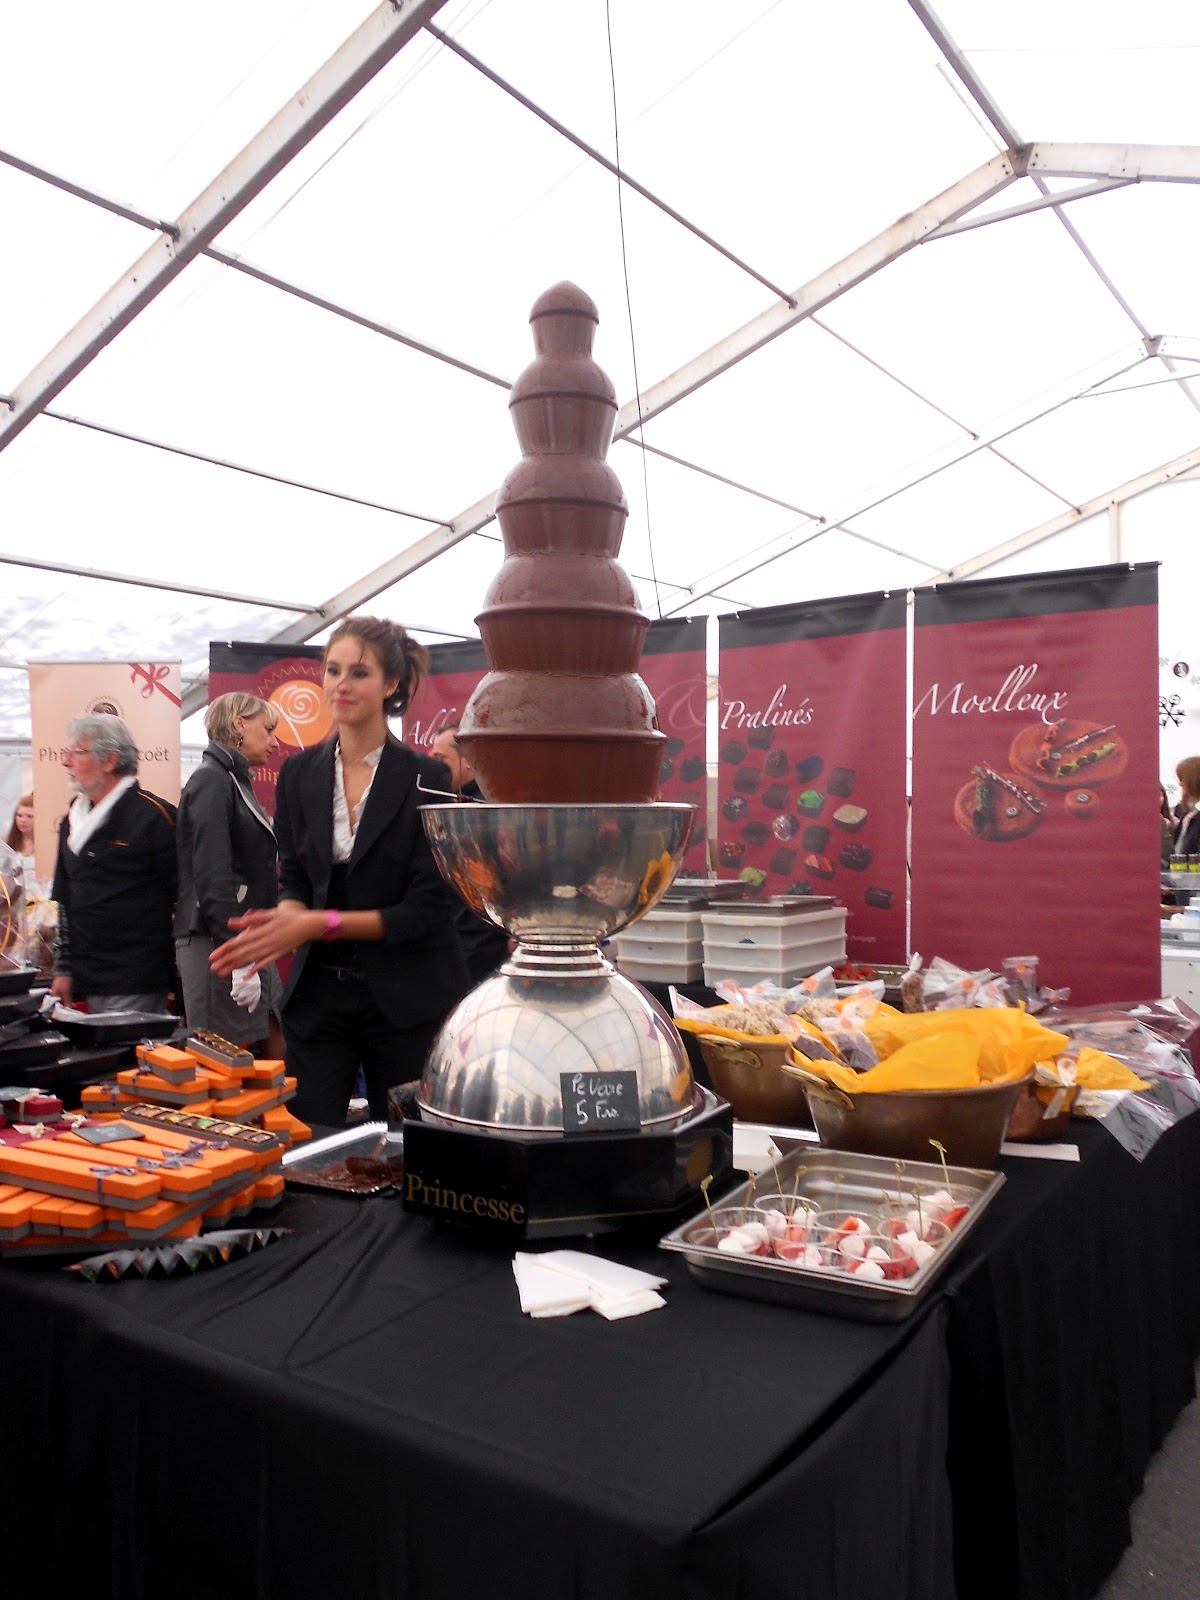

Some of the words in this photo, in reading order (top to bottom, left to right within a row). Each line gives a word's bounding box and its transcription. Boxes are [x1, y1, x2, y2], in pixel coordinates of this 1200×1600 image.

[720, 683, 814, 730] Pralinés
[912, 663, 1069, 725] Moelleux
[137, 747, 170, 761] coët
[576, 1098, 589, 1125] 5
[405, 1172, 526, 1225] Princesse
